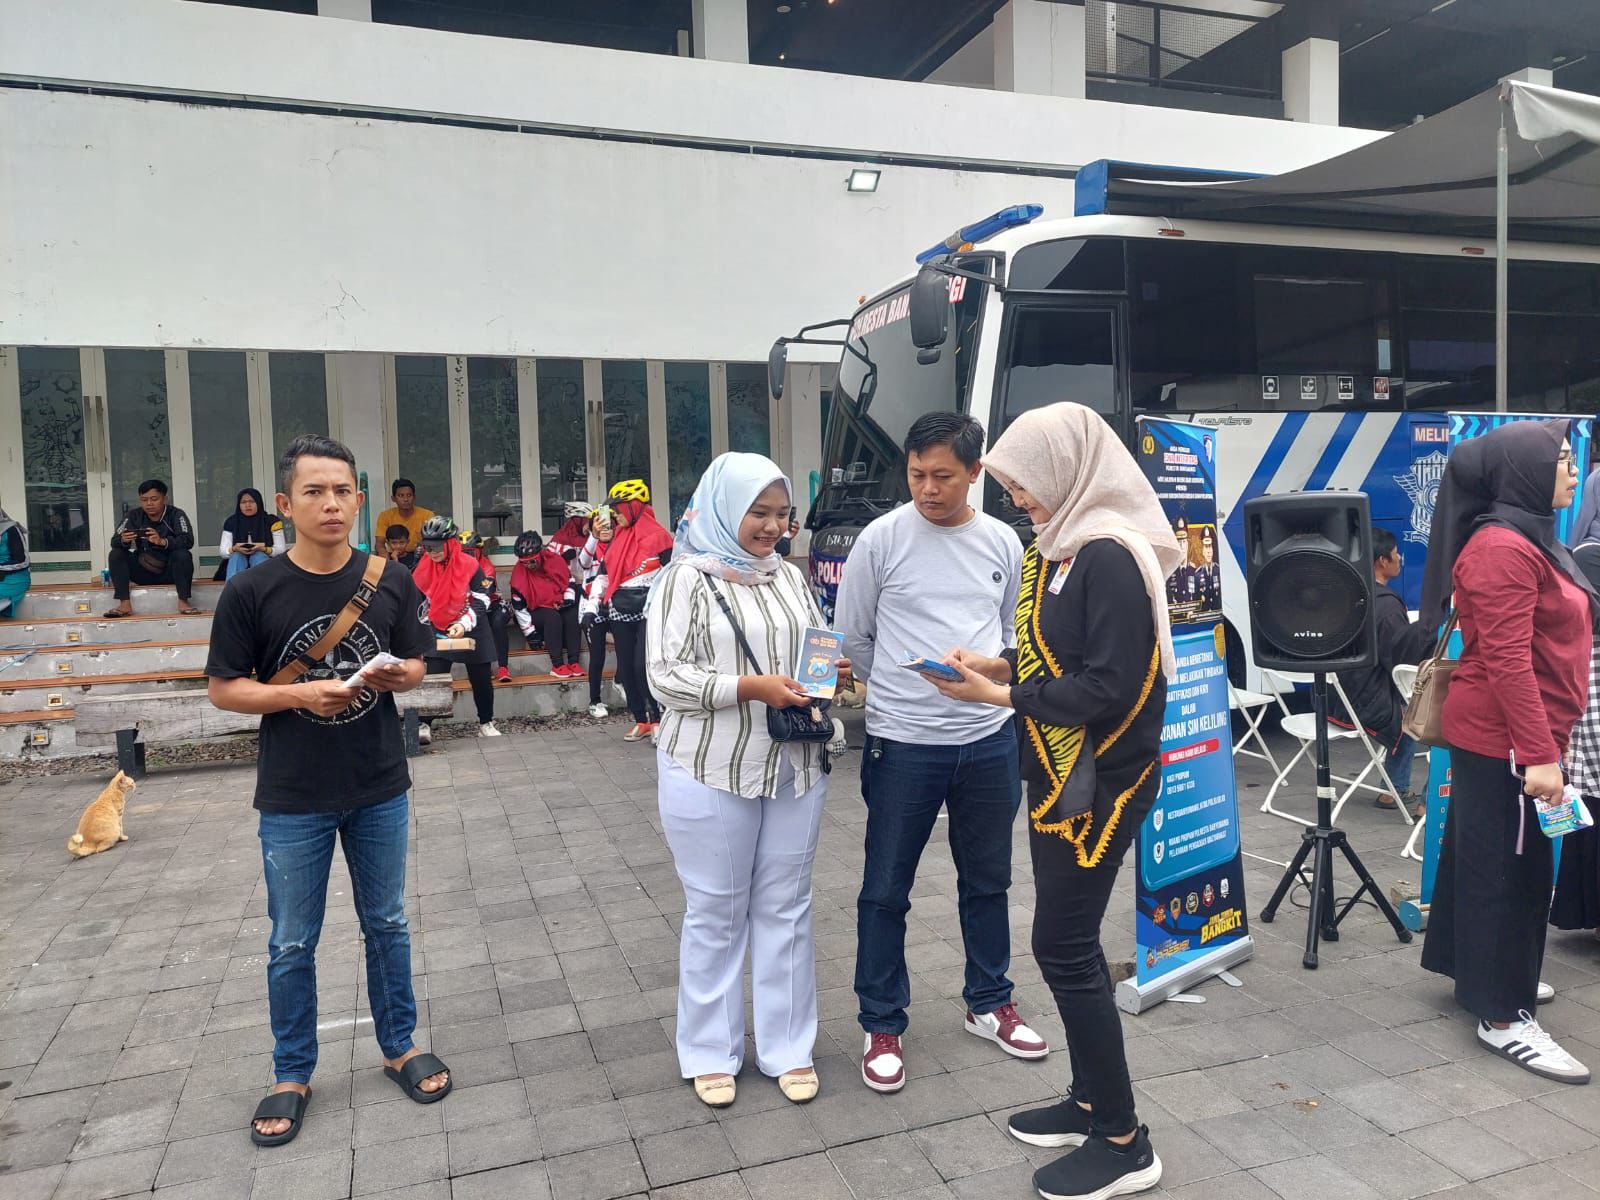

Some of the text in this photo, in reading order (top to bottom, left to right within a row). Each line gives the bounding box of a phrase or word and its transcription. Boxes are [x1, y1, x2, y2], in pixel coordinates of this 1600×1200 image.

[1415, 427, 1449, 442] MELI
[1181, 703, 1196, 716] DALAM
[1187, 717, 1199, 736] SIM
[1200, 711, 1227, 732] KELILING
[1200, 910, 1242, 945] BANGKIT
